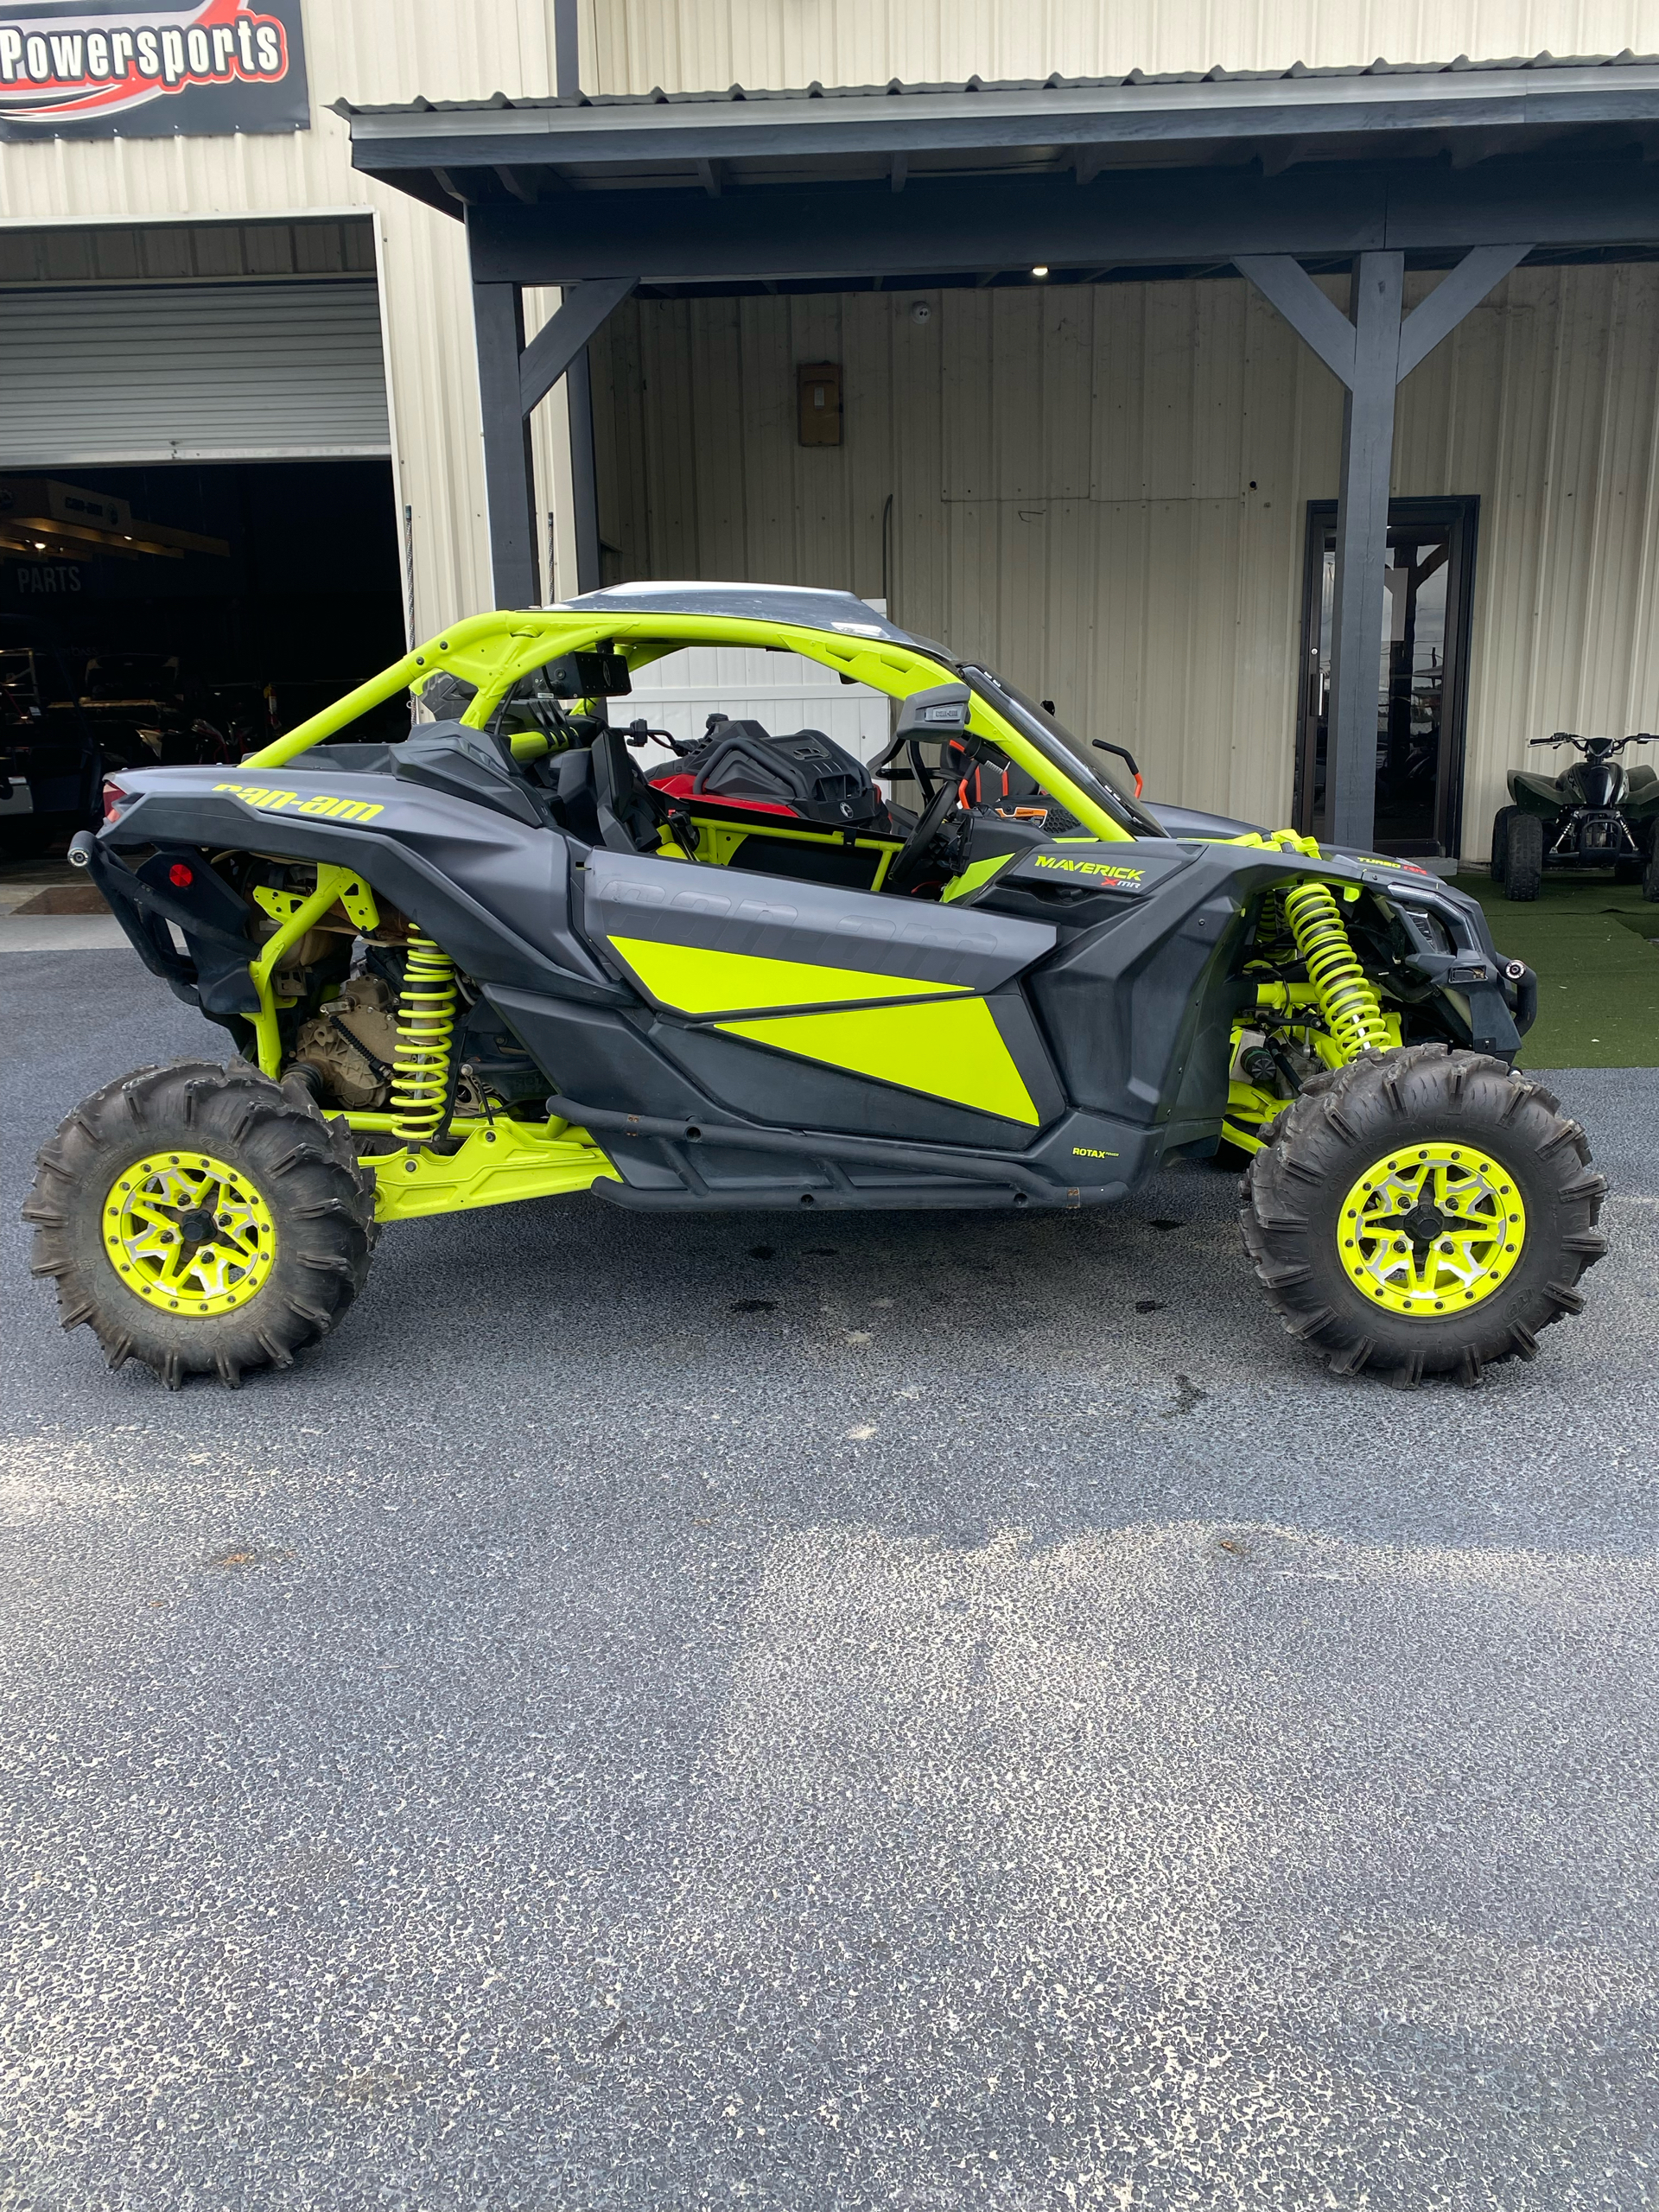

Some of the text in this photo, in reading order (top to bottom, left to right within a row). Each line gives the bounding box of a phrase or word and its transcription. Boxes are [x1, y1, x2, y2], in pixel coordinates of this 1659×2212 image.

[0, 19, 279, 82] Powersports
[16, 565, 81, 593] PARTS
[1033, 855, 1147, 881] MAVERICK
[1357, 856, 1402, 869] TURBO
[1071, 1147, 1106, 1159] ROTAX
